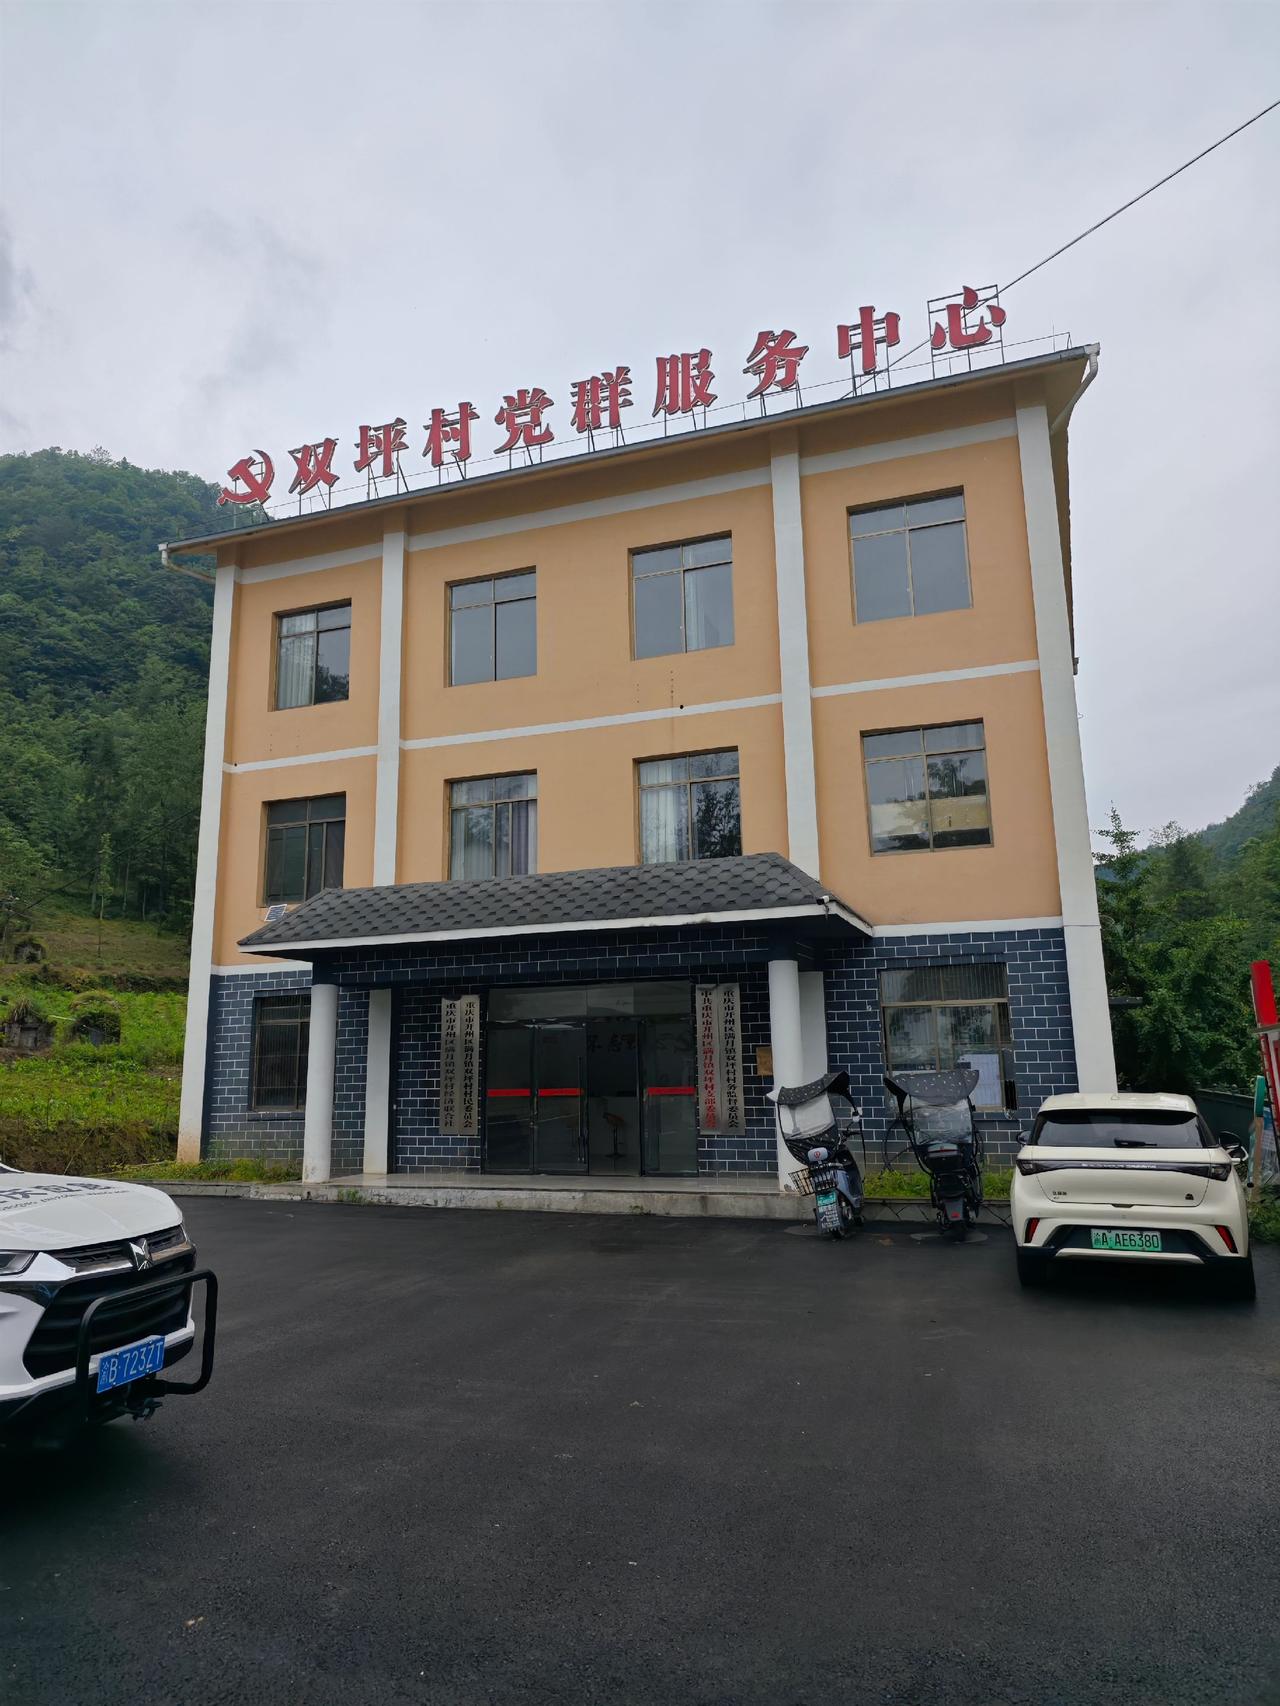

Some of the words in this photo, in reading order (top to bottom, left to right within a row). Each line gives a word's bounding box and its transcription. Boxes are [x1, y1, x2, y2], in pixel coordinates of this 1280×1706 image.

[287, 285, 1007, 496] 双坪村党群服务中心
